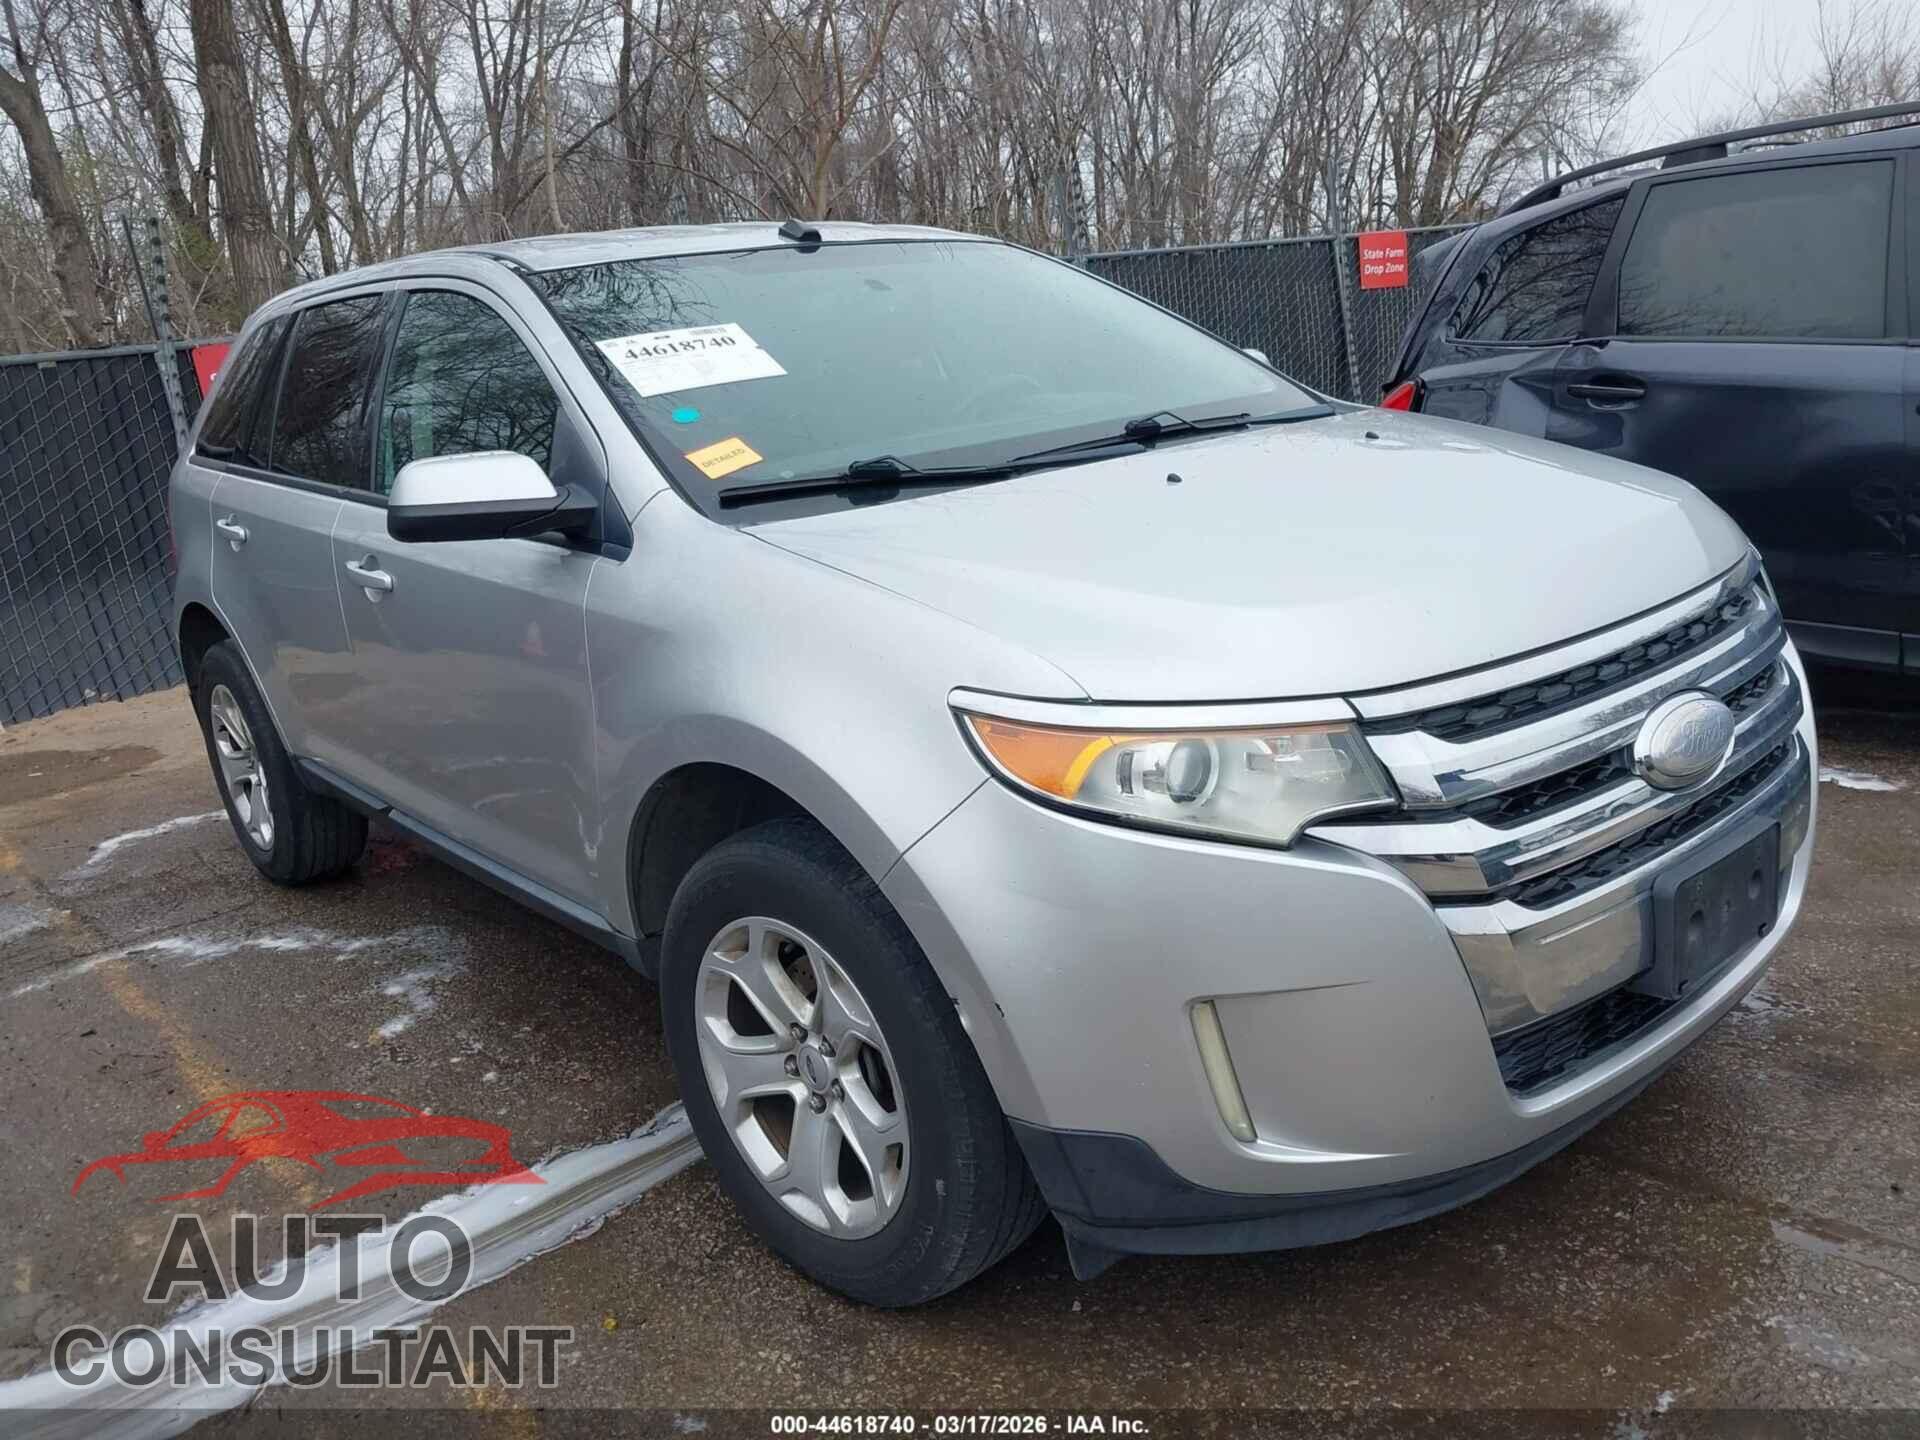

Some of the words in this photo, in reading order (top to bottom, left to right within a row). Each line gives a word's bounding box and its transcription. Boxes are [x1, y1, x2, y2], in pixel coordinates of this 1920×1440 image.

[1363, 249, 1383, 260] State
[1385, 248, 1405, 258] Farm
[1365, 264, 1384, 276] Drop
[1385, 262, 1405, 273] Zone
[624, 336, 737, 359] 44618740
[702, 447, 746, 469] DETAILED
